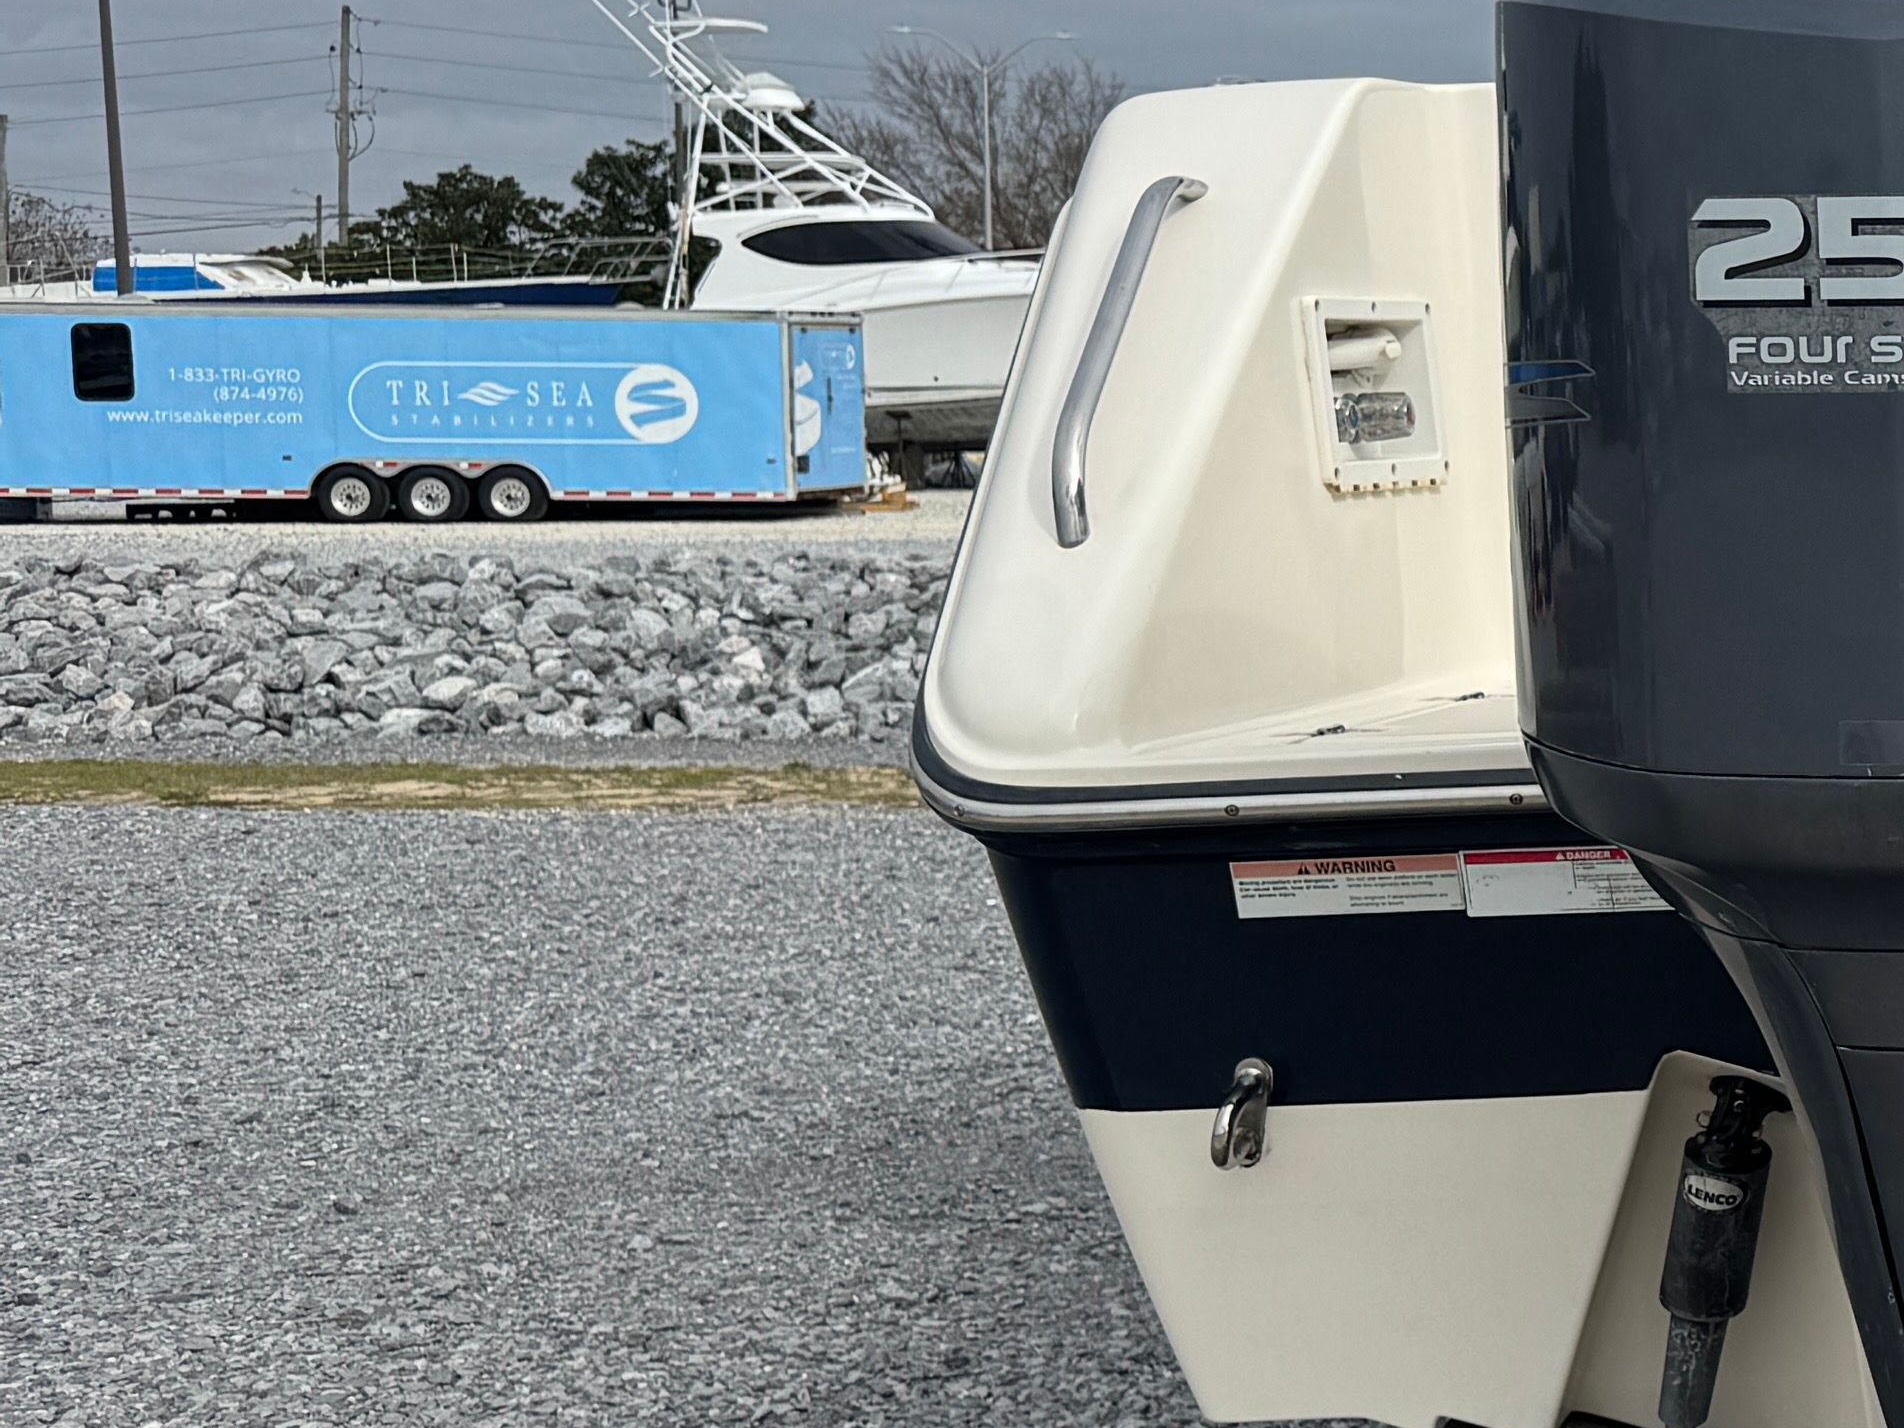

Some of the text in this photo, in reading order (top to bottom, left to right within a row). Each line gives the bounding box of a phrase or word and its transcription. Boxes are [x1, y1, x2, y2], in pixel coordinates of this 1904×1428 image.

[168, 367, 301, 384] 1-833-TRI-GYRO
[1730, 371, 1834, 387] Variable
[213, 386, 305, 404] (874-4976)
[386, 380, 593, 408] TRI SEA
[107, 408, 303, 427] www.triseakeeper.com
[390, 413, 595, 427] STABILIZERS
[1566, 850, 1611, 861] DANGER
[1315, 859, 1396, 875] WARNING
[1687, 1184, 1738, 1206] LENCO
